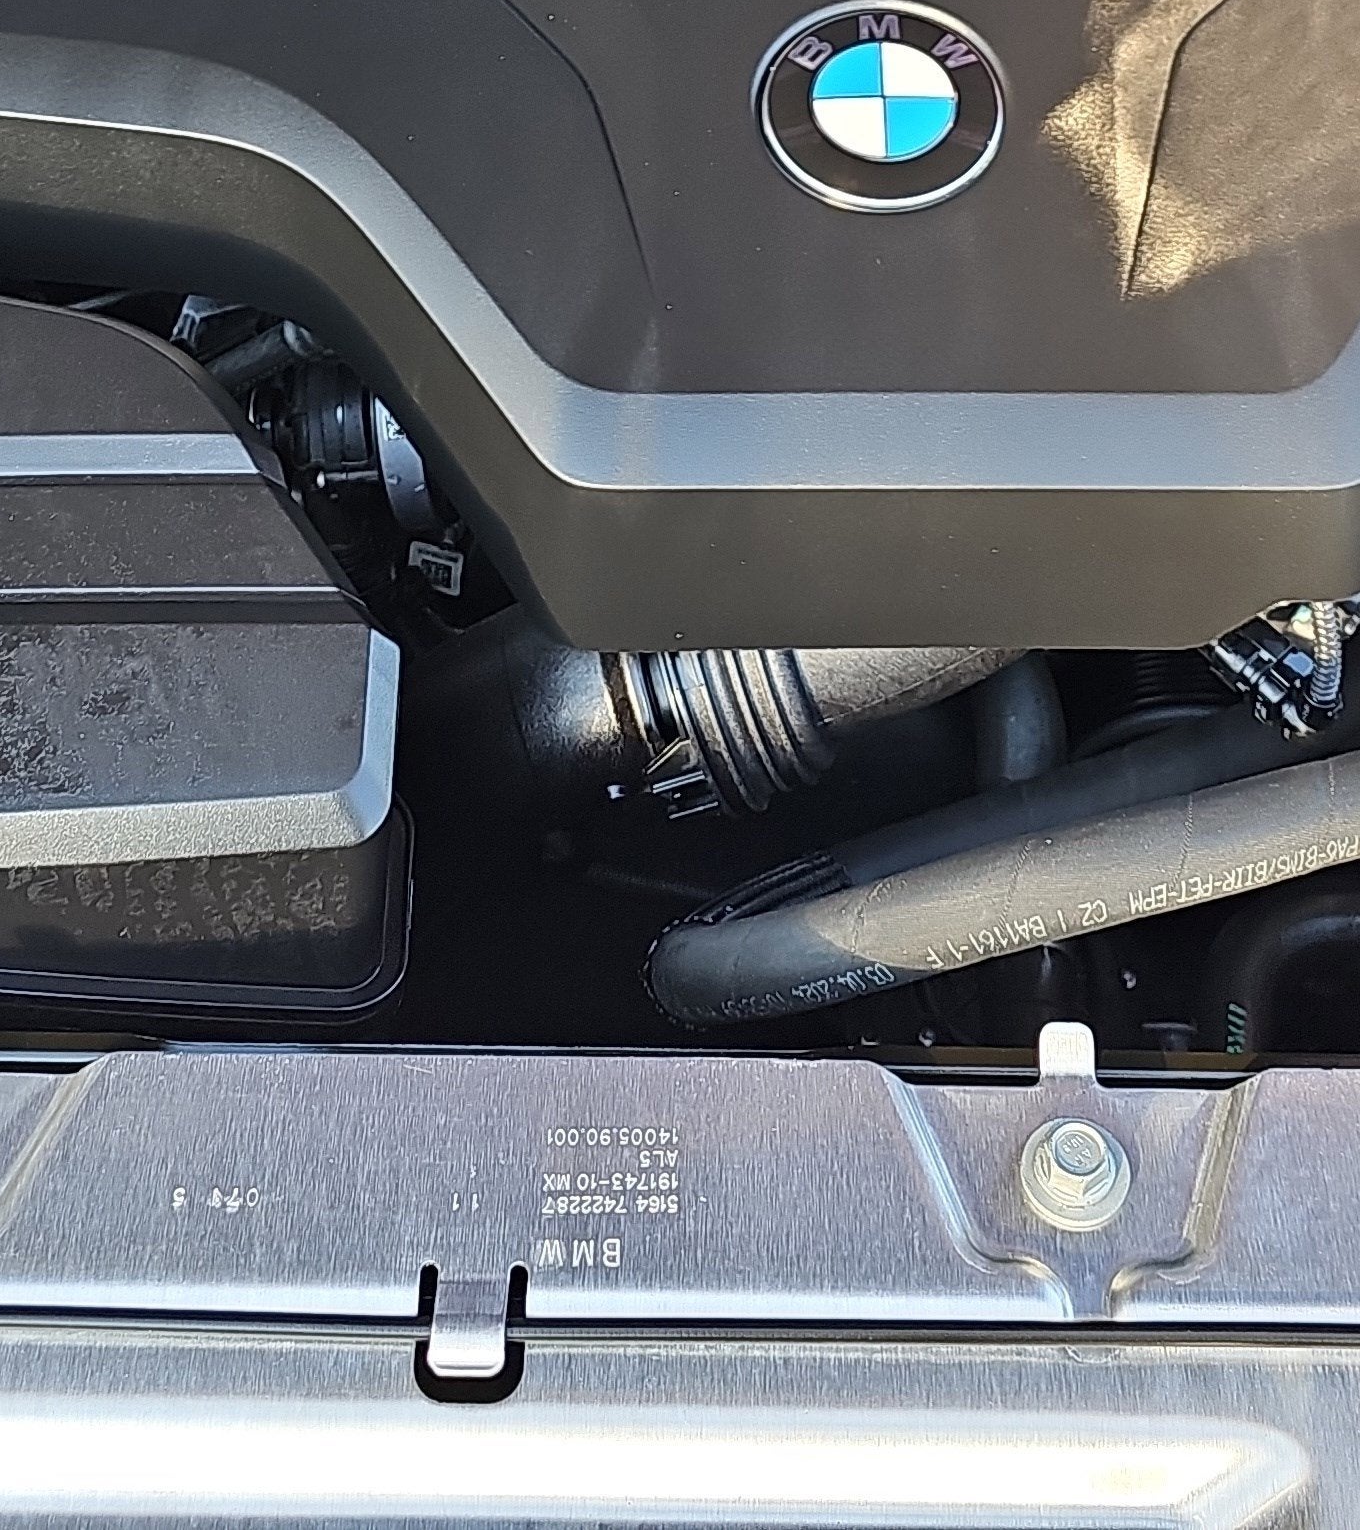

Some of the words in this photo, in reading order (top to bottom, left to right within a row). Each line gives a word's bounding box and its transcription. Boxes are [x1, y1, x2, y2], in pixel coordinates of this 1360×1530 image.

[788, 14, 981, 71] BMW
[547, 1127, 679, 1146] 14005.90.001
[639, 1149, 679, 1168] AL5
[542, 1172, 571, 1192] MX
[576, 1172, 679, 1191] 191743-10
[541, 1195, 628, 1215] 7422287
[635, 1194, 679, 1214] 5164
